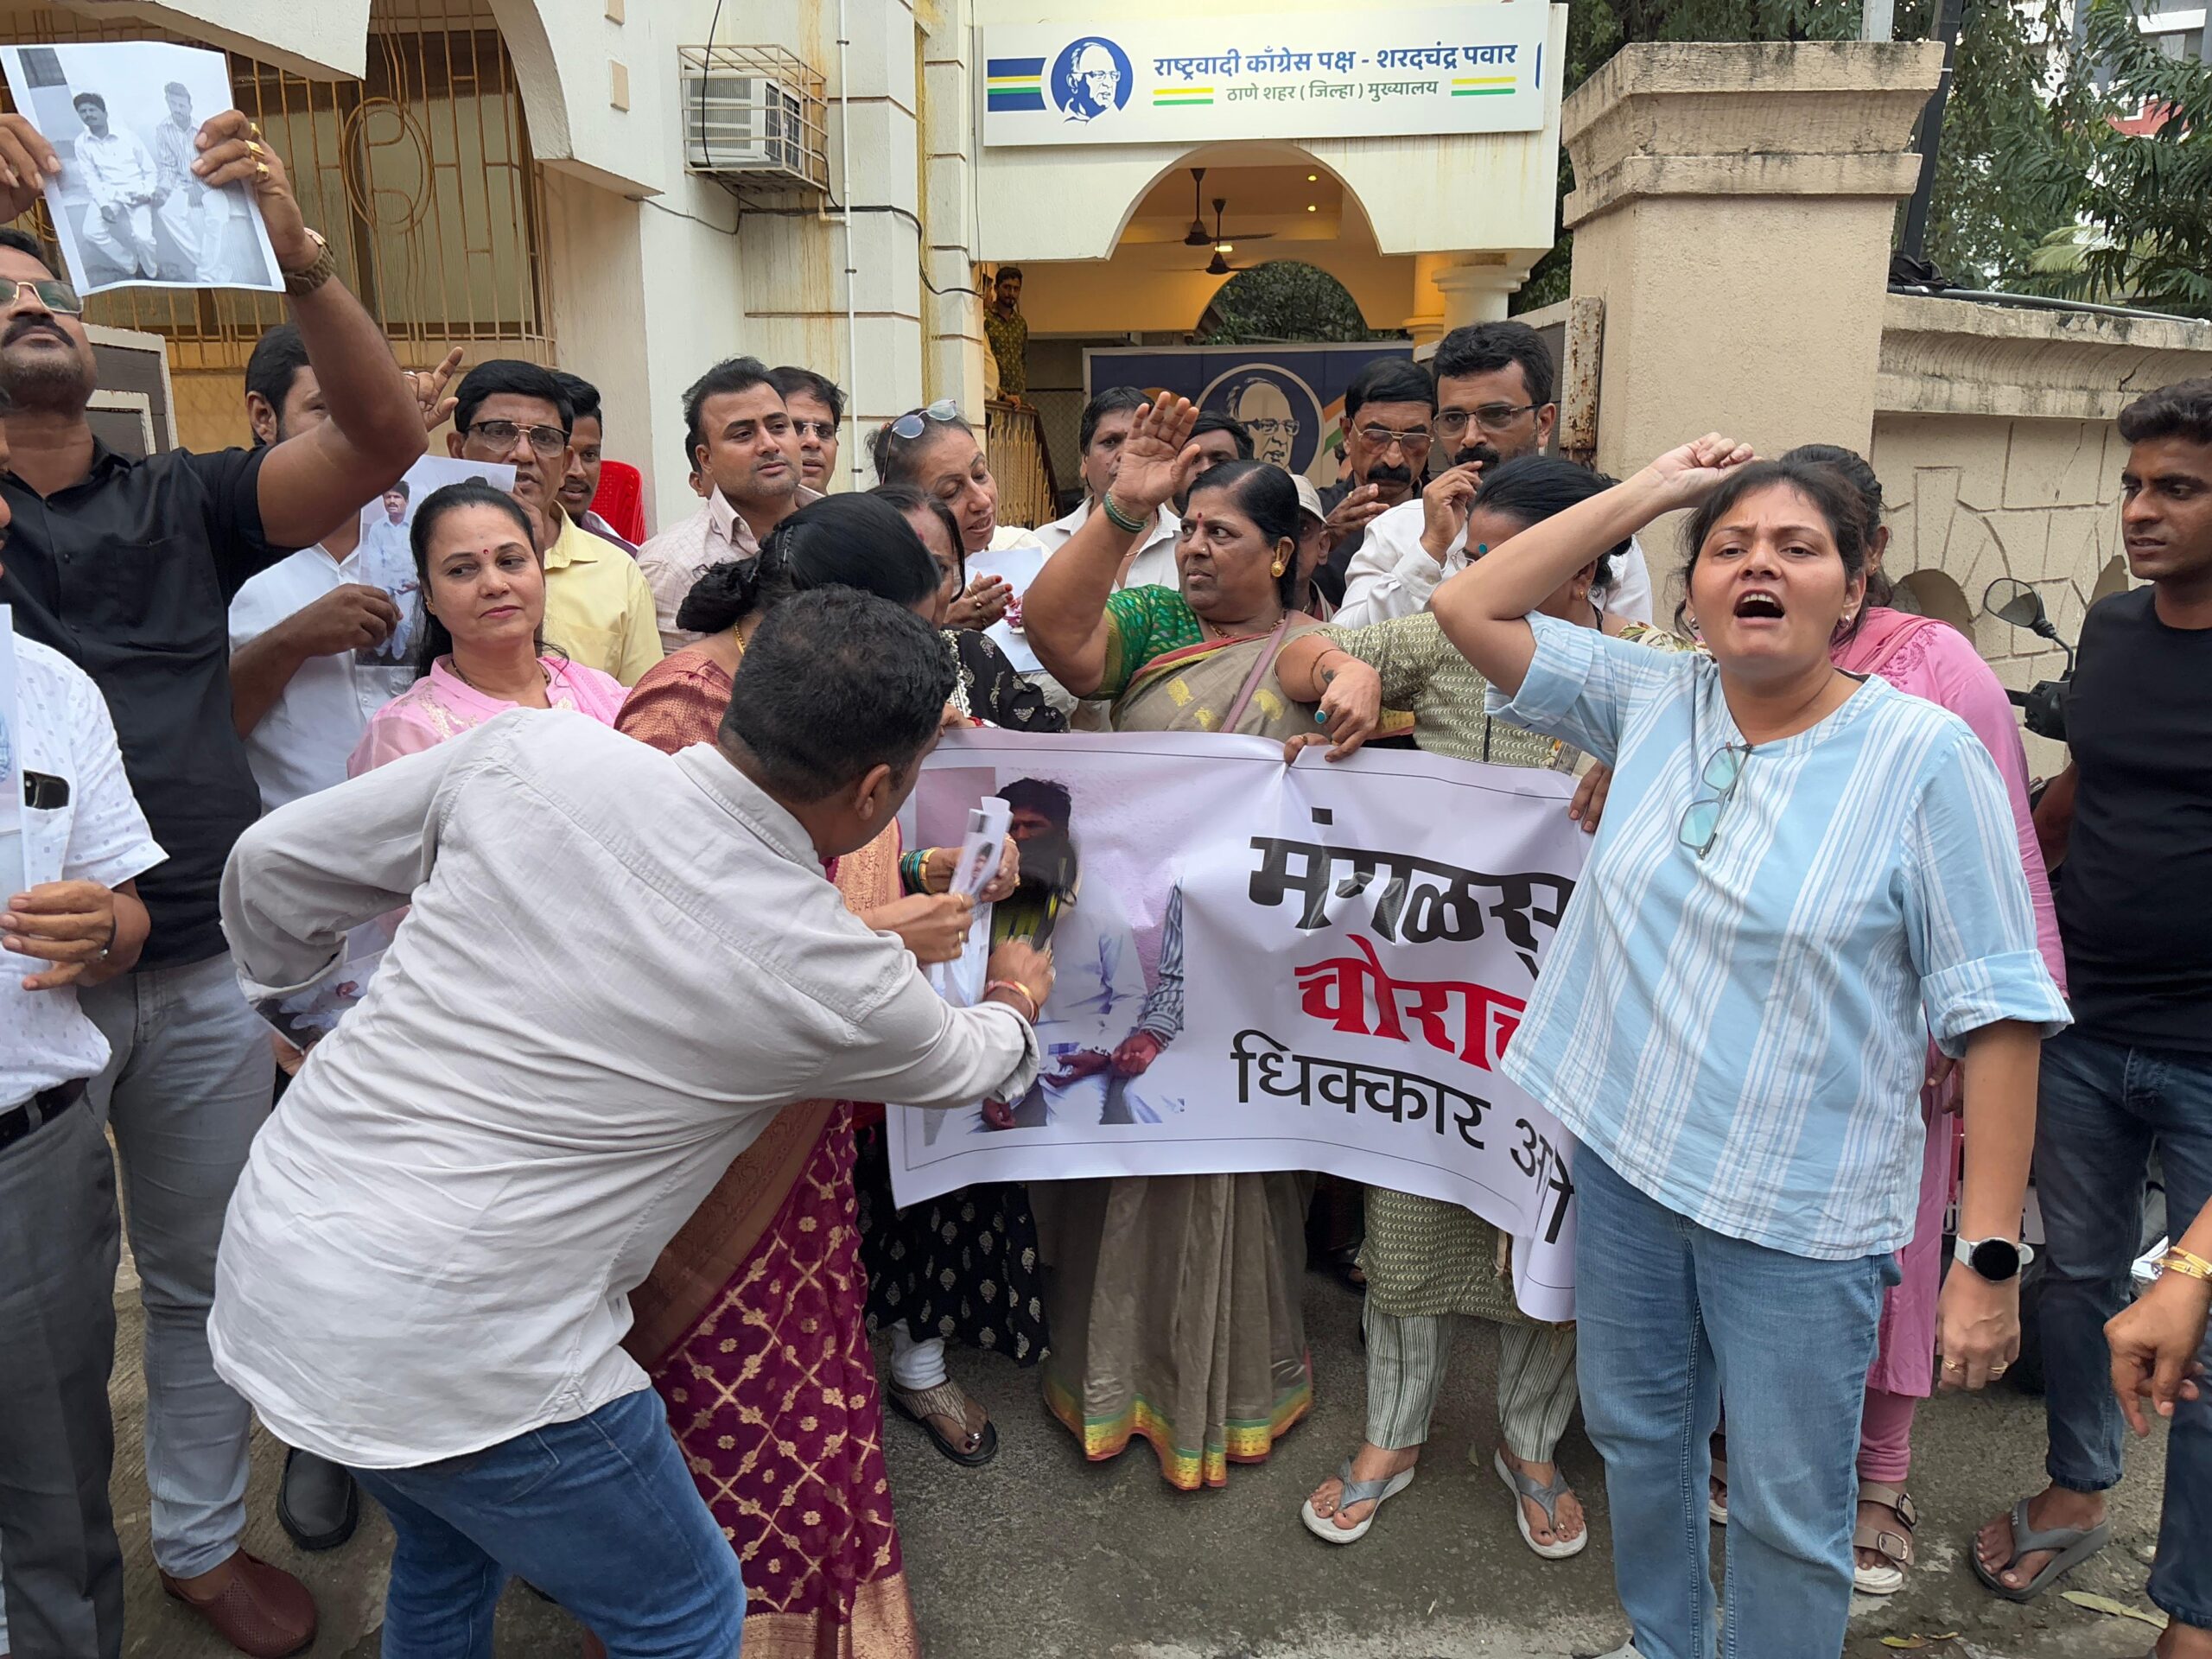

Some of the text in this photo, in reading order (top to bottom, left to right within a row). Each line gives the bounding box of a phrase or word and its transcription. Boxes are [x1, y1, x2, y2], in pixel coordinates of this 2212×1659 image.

[1154, 48, 1242, 80] राष्ट्रवादी
[1317, 51, 1357, 73] पक्ष
[1376, 41, 1459, 70] शरदचंद्र
[1462, 44, 1518, 65] पवार
[1226, 83, 1259, 101] ठाणे
[1262, 86, 1296, 101] शहर
[1368, 81, 1439, 102] मुख्यालय
[1230, 1028, 1491, 1150] धिक्कार
